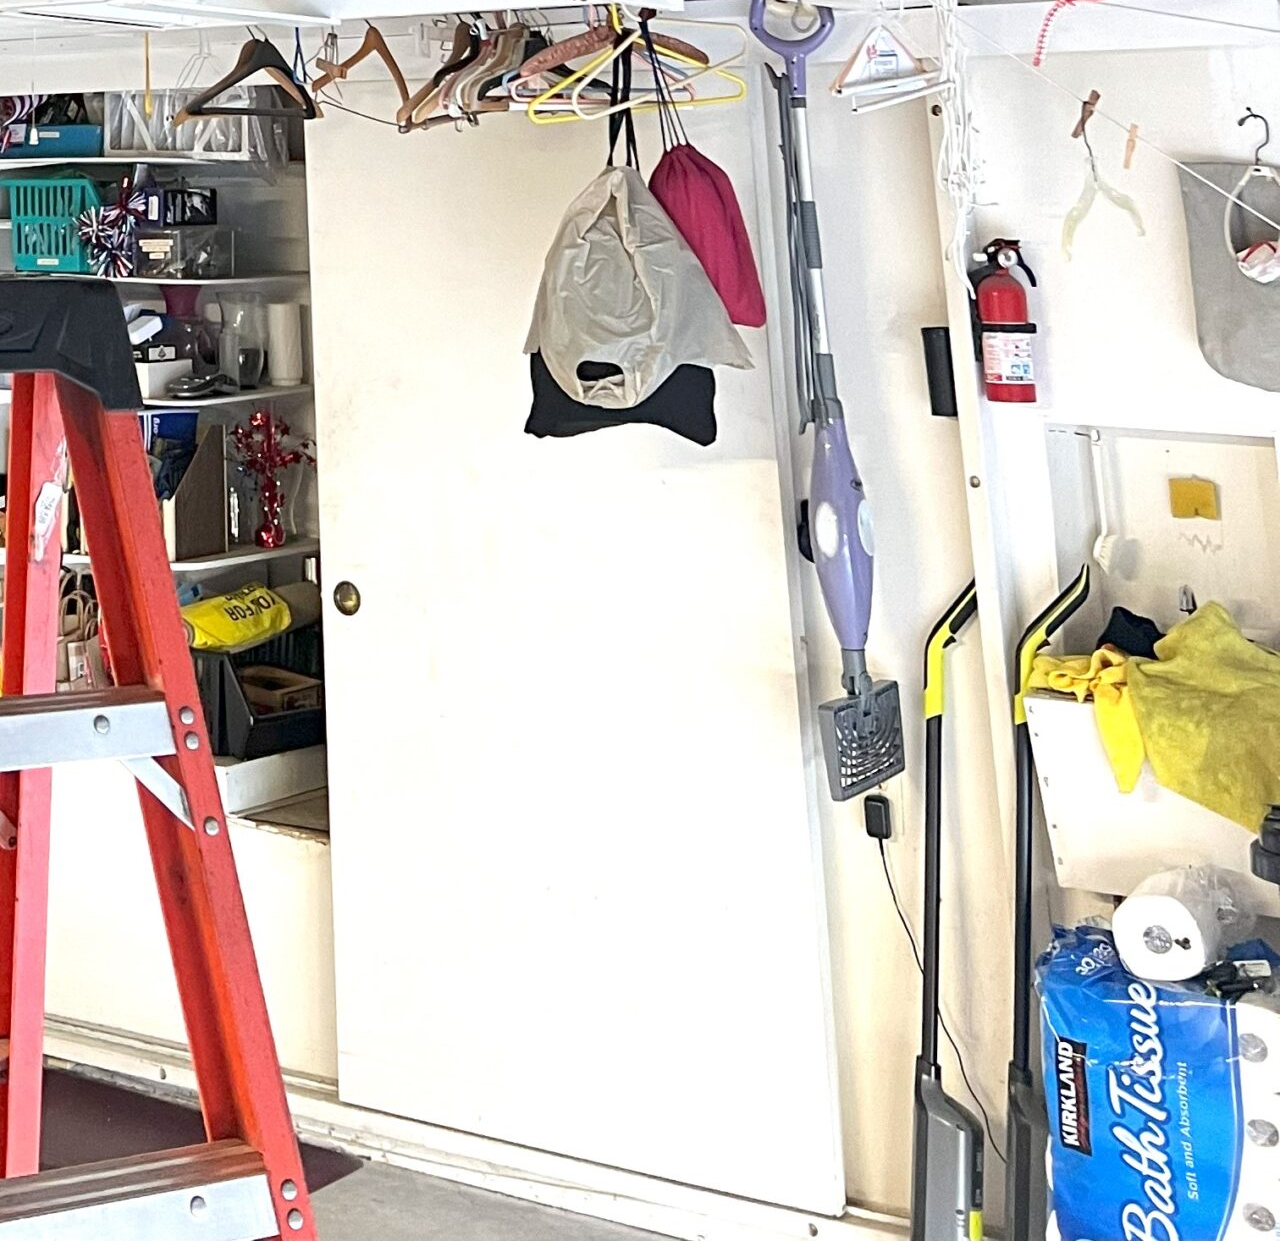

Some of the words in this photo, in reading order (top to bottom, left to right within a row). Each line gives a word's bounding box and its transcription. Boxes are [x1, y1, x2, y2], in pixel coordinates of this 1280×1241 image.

[1057, 1041, 1081, 1147] KIRKLAND
[1108, 981, 1168, 1121] Tissue
[1176, 1061, 1192, 1139] Absorbent
[1111, 1121, 1180, 1241] Bath
[1180, 1140, 1195, 1169] and
[1186, 1170, 1199, 1201] Soft
